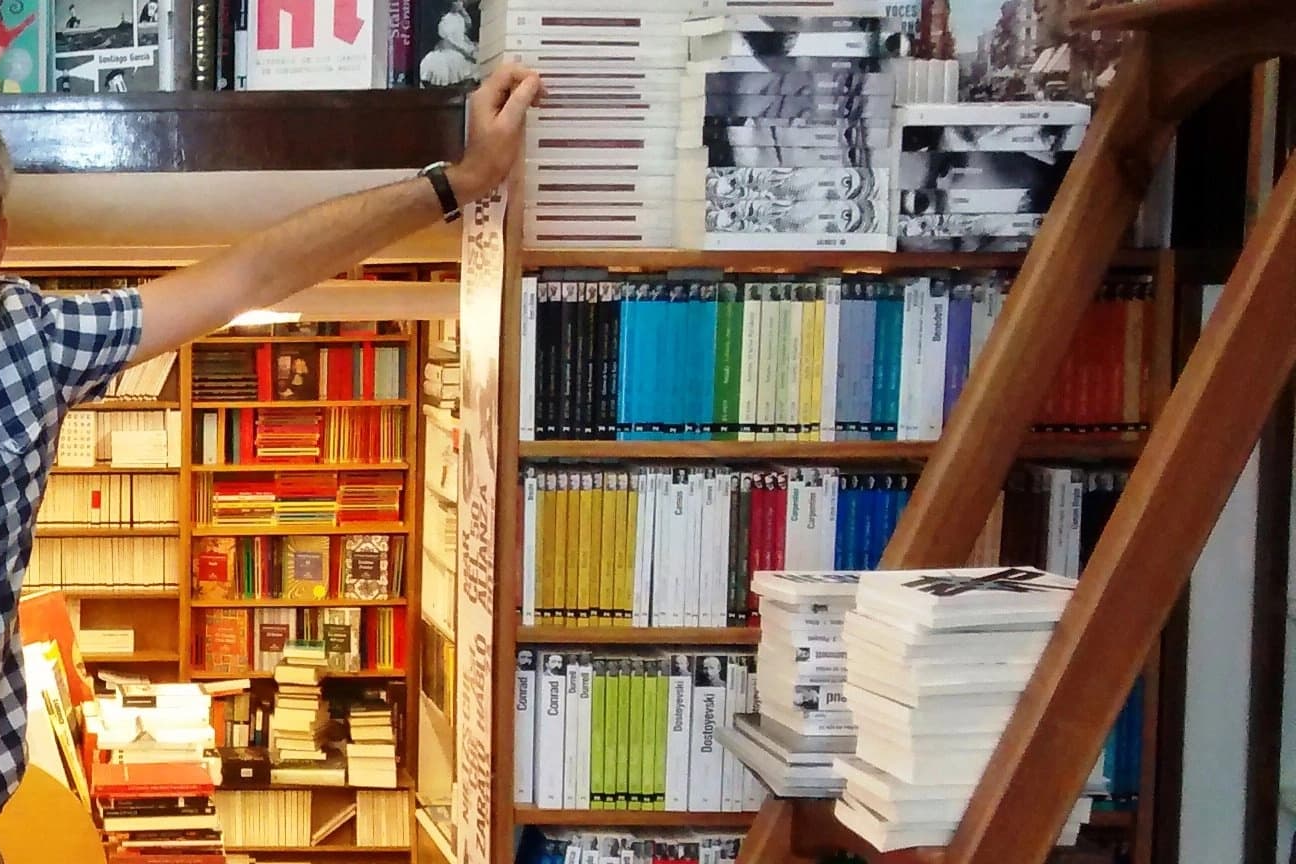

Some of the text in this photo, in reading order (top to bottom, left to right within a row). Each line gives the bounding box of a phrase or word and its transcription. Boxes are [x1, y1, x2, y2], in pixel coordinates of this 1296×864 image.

[885, 4, 918, 17] VOCES
[932, 303, 943, 342] Benedetti
[517, 676, 528, 711] Conrad
[547, 680, 559, 717] Conrad
[580, 672, 589, 699] Durrell
[673, 680, 684, 732] Dostoyevski
[701, 693, 715, 753] Dostoyevski
